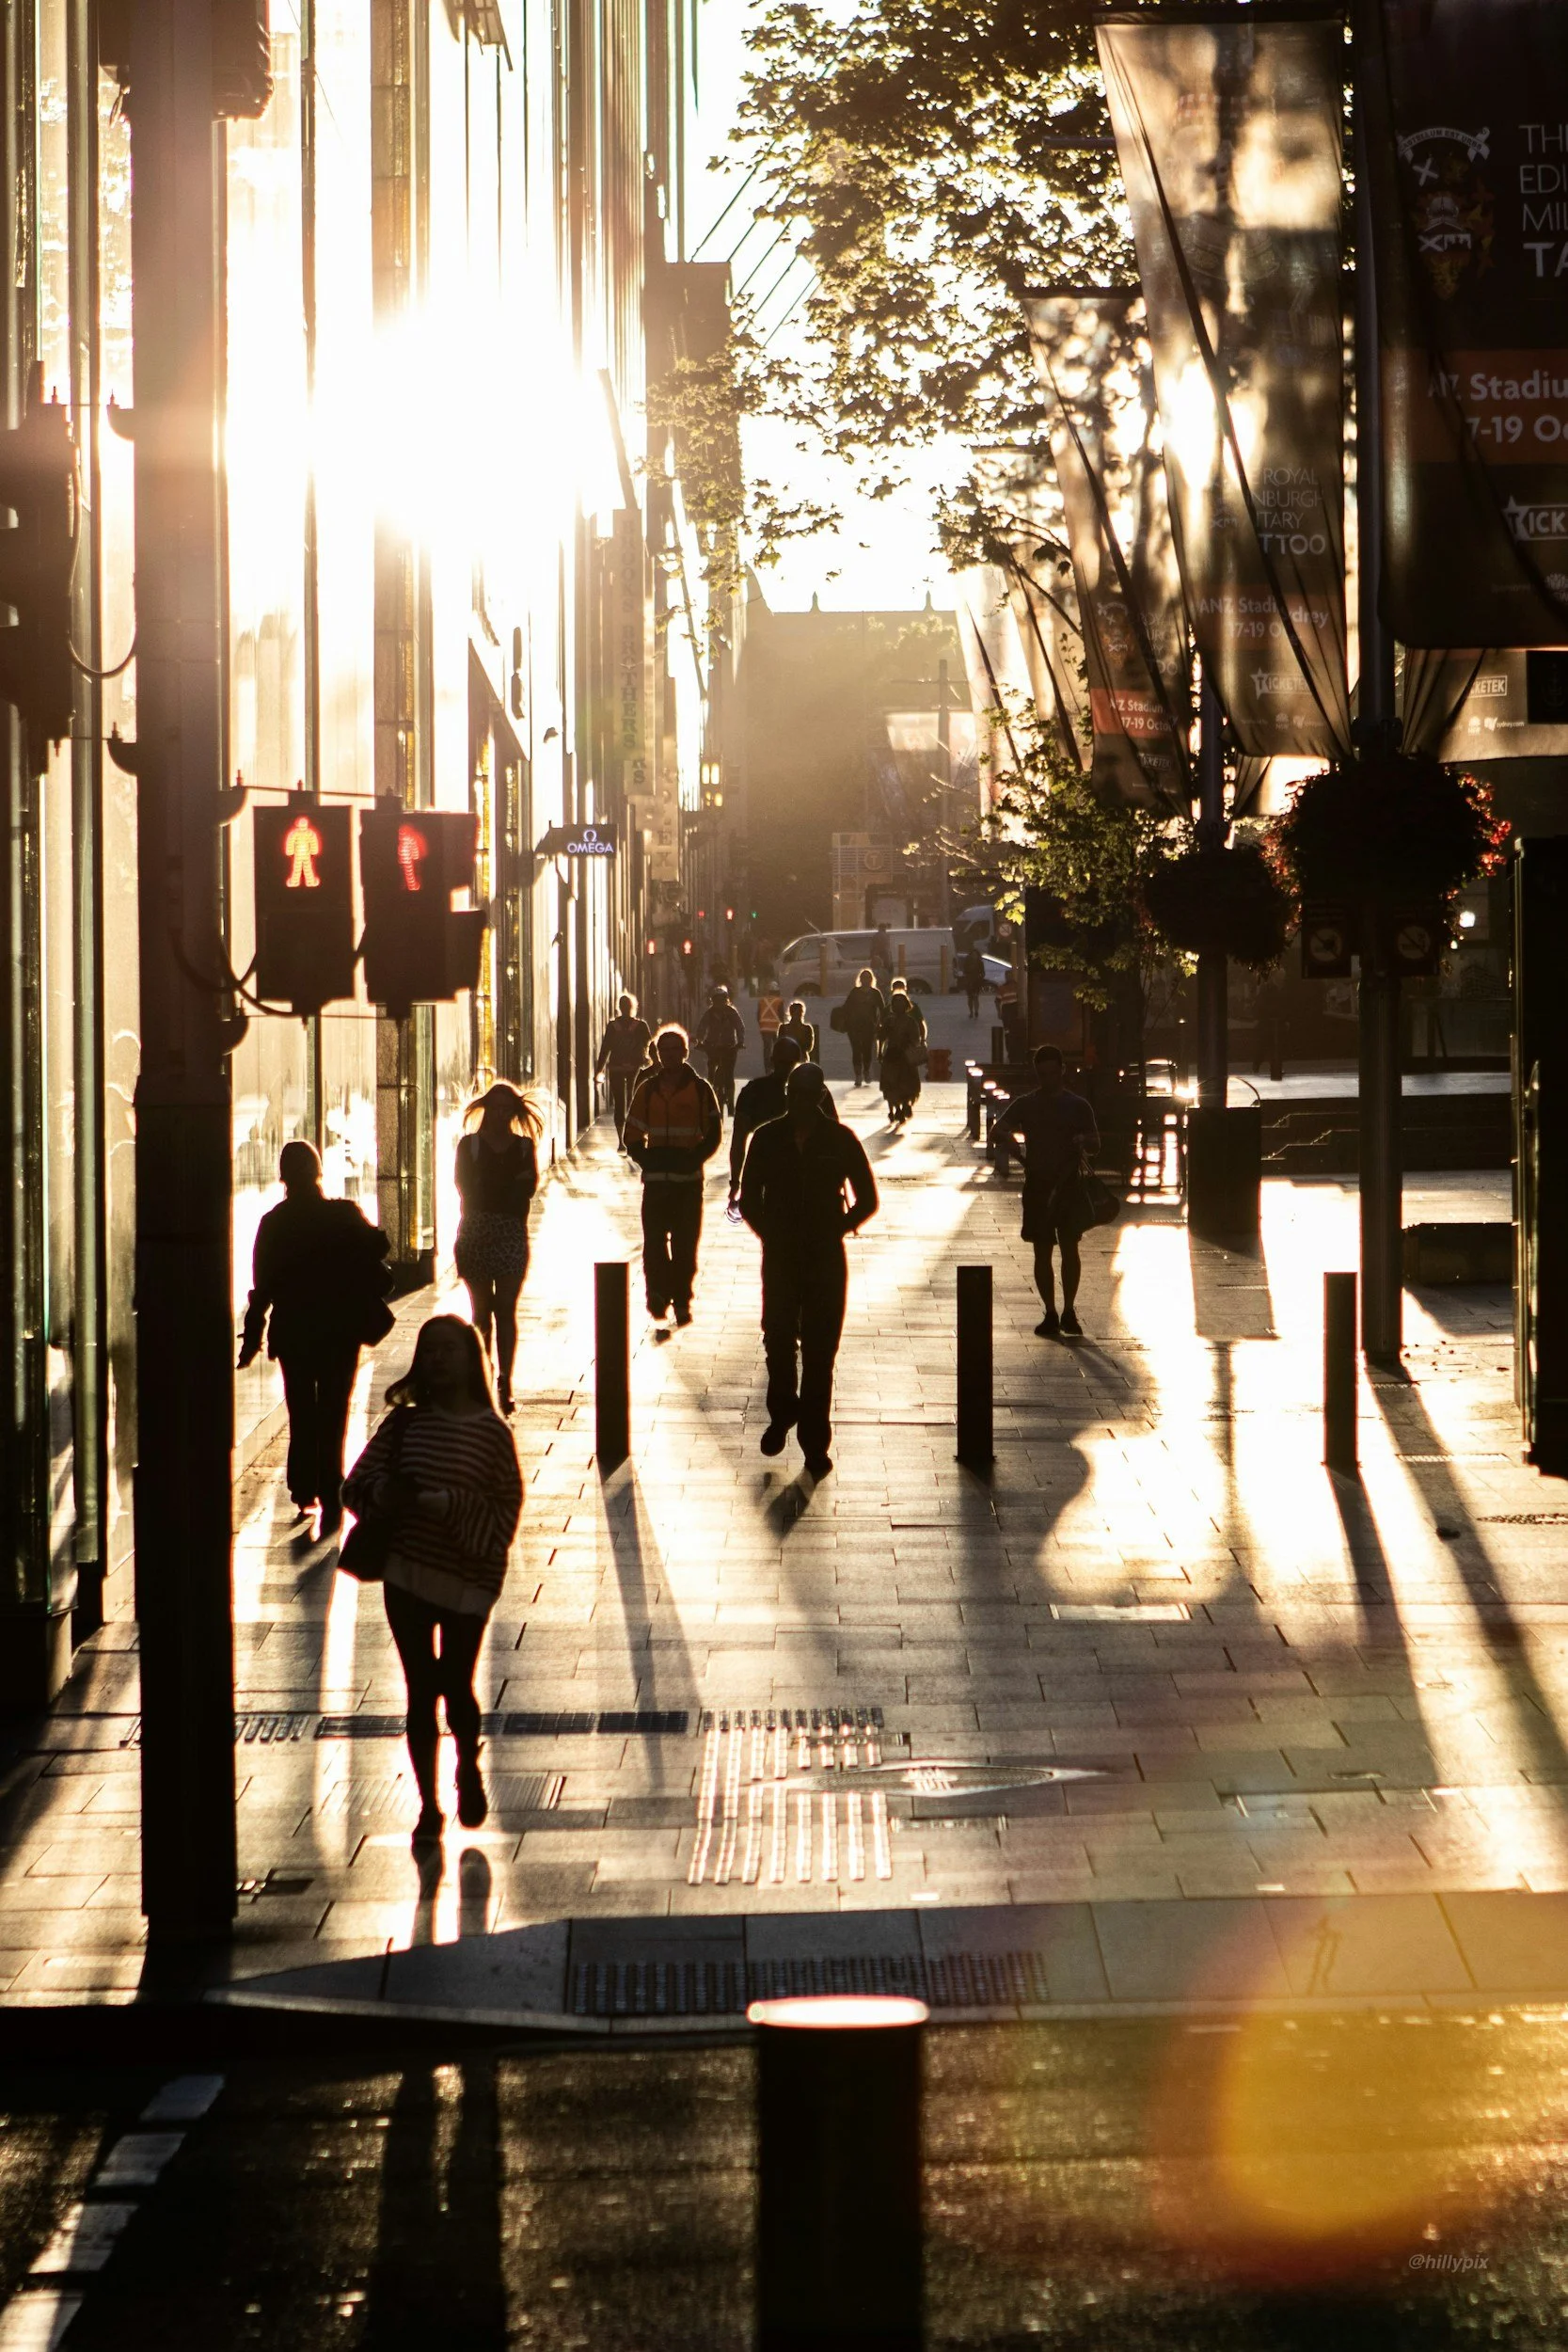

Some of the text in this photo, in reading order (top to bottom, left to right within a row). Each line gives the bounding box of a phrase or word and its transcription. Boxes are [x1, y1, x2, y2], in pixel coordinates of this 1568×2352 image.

[1518, 123, 1568, 154] TH
[1263, 467, 1319, 486] ROYAL
[1252, 489, 1324, 508] NBURGH
[1258, 532, 1326, 556] TTOO
[566, 843, 614, 853] OMEGA
